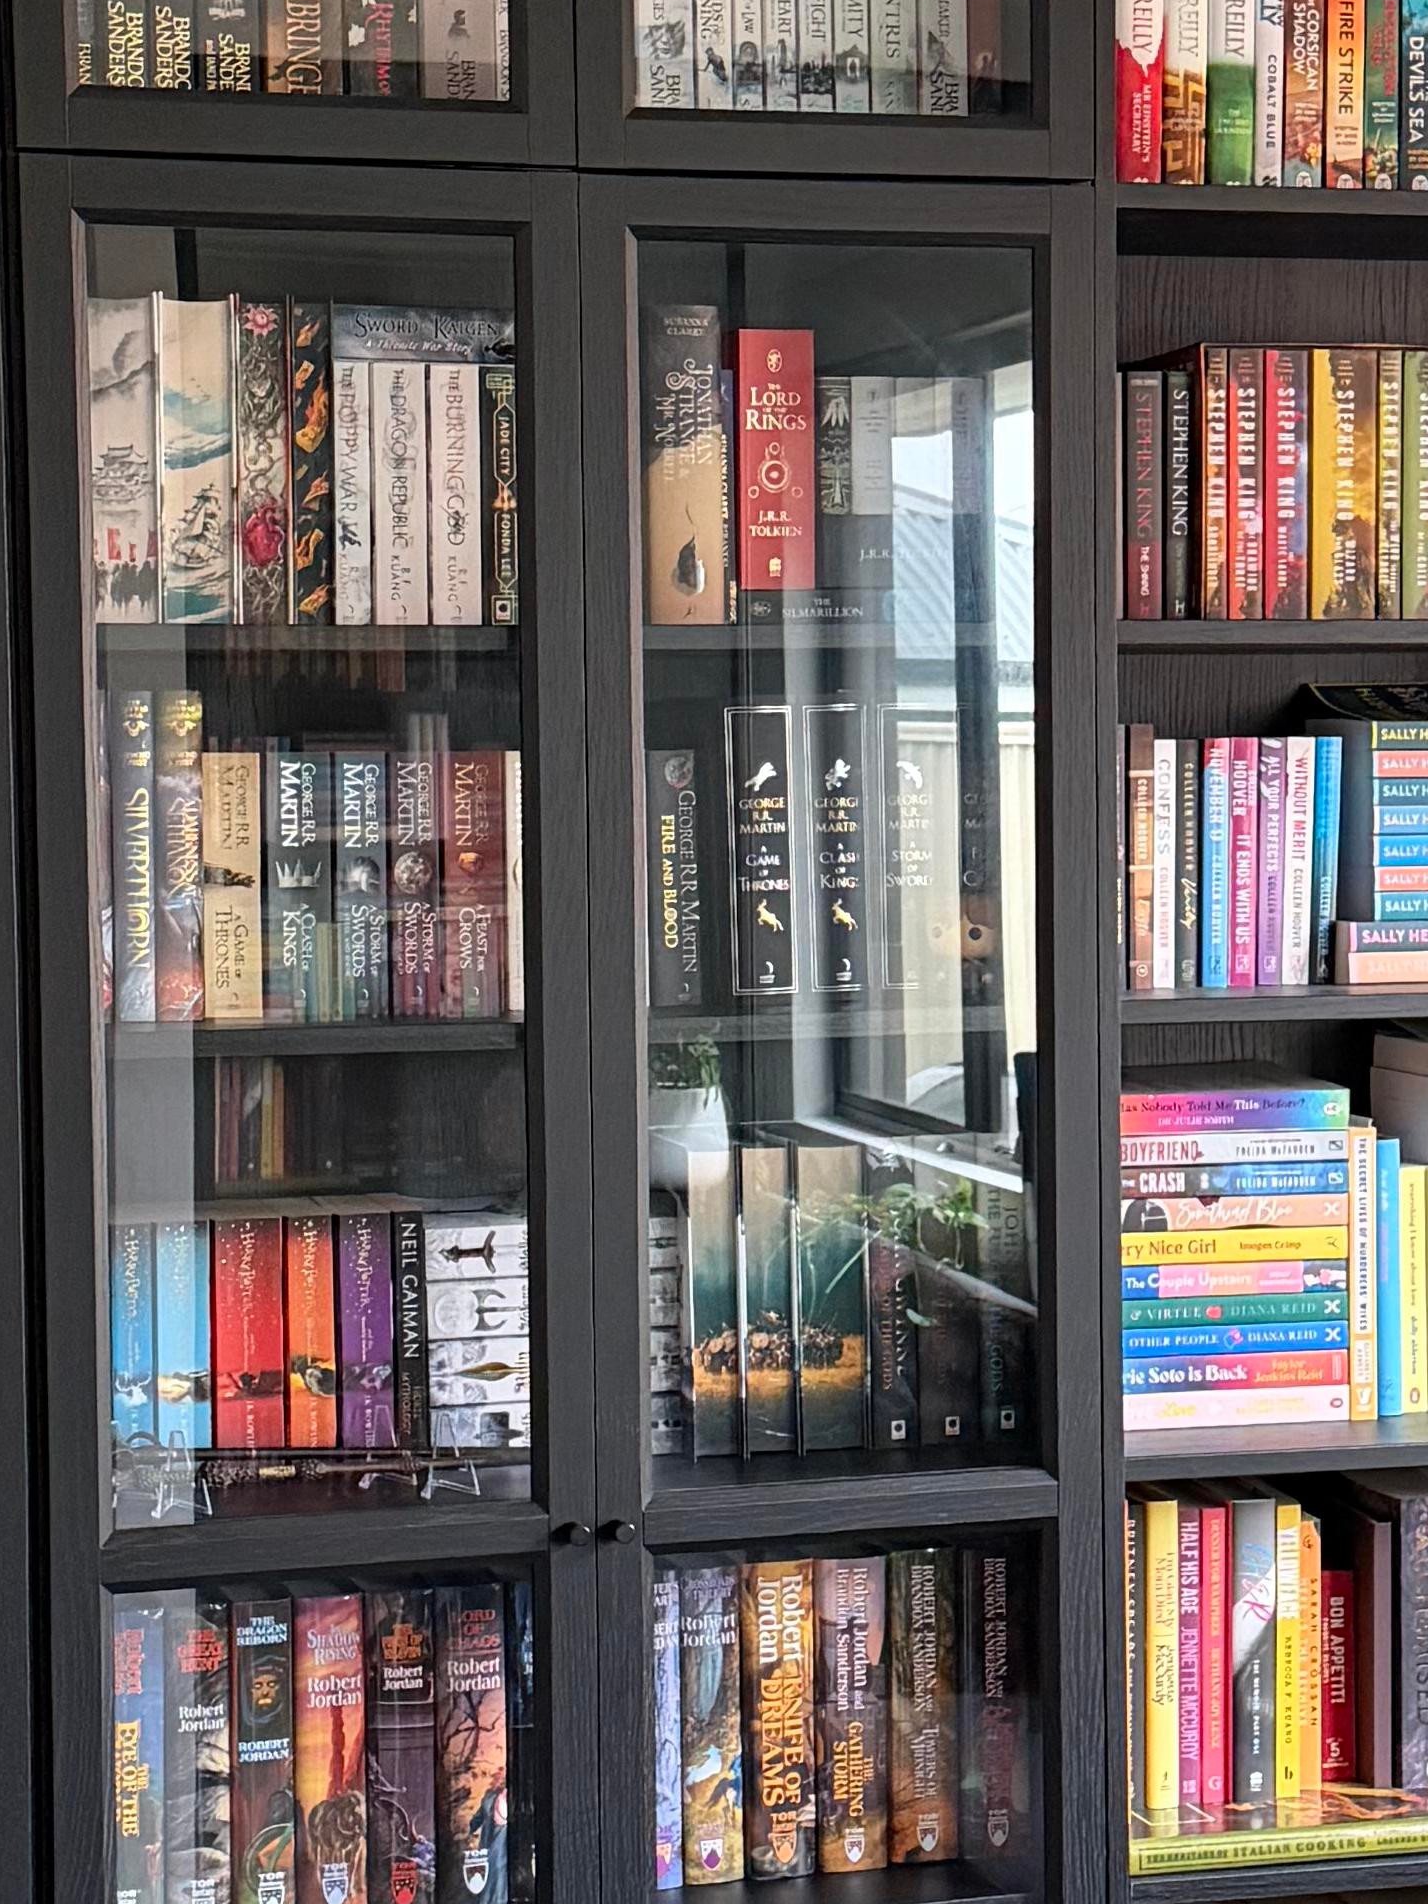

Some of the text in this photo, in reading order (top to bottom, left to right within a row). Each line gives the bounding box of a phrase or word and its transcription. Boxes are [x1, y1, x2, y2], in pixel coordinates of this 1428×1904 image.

[1339, 0, 1354, 41] FIRE
[1339, 47, 1354, 114] STRIKE
[1267, 55, 1277, 147] COBALT BLUE
[750, 387, 800, 406] LORD
[745, 410, 807, 431] RINGS
[1172, 389, 1189, 536] STEPHEN KING
[1237, 389, 1256, 521] STEPHEN KING
[1278, 388, 1296, 519] STEPHEN KING
[749, 526, 802, 537] TOLKIEN
[1381, 728, 1417, 740] SALLY
[1382, 784, 1419, 796] SALLY
[281, 762, 298, 846] MARTIN
[1384, 813, 1420, 826] SALLY
[662, 815, 678, 948] FIRE BLOOD
[1140, 1174, 1185, 1192] CRASH
[1149, 1240, 1216, 1255] Nice Girl
[401, 1223, 418, 1358] NEIL GAIMAN
[1248, 1330, 1316, 1343] DIANA REID
[1148, 1364, 1247, 1383] Soto Back
[757, 1578, 778, 1664] Jordan
[447, 1659, 500, 1675] Robert
[308, 1674, 362, 1690] Robert
[447, 1674, 500, 1692] Jordan
[306, 1690, 362, 1708] Jordan
[761, 1679, 784, 1807] DREAMS
[833, 1742, 848, 1801] STORM
[1233, 1838, 1366, 1858] ITALIAN COOKING
